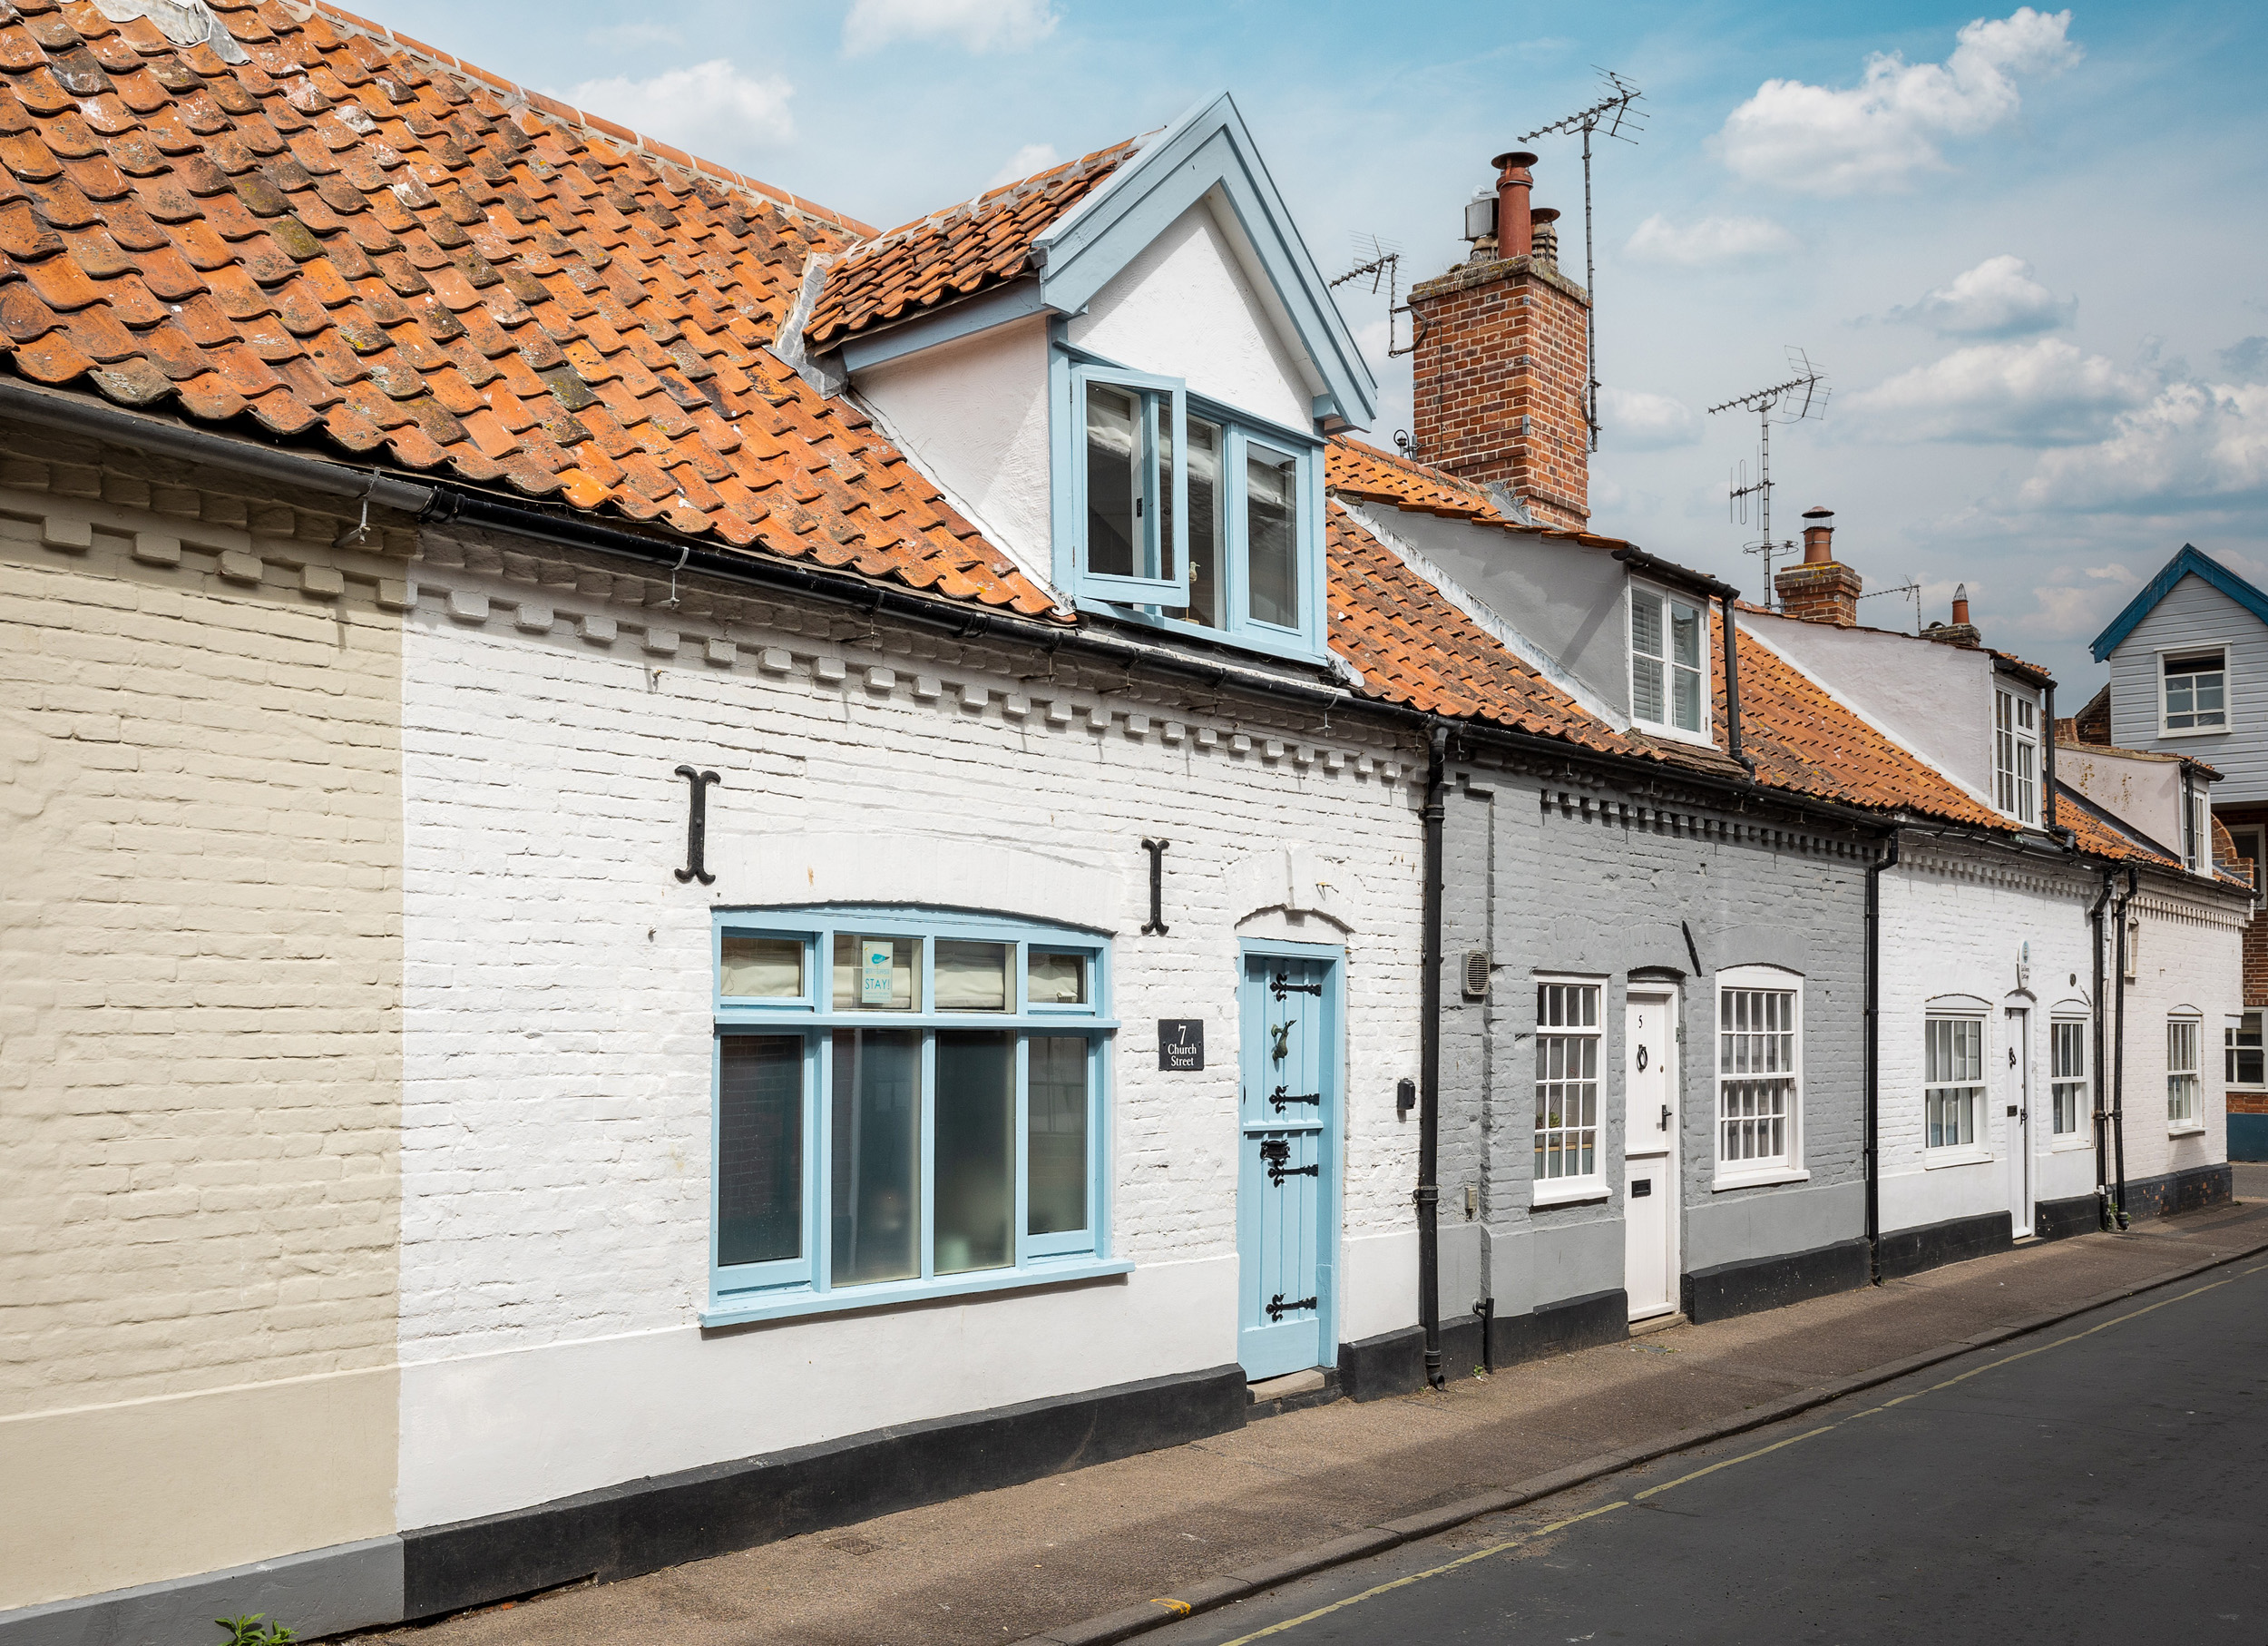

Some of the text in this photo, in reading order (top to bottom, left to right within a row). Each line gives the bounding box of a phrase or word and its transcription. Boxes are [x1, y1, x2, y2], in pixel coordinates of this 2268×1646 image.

[865, 978, 890, 990] STAY!
[1638, 1014, 1643, 1029] 5
[1178, 1024, 1187, 1045] 7
[1168, 1043, 1197, 1054] Church
[1170, 1055, 1194, 1066] Street
